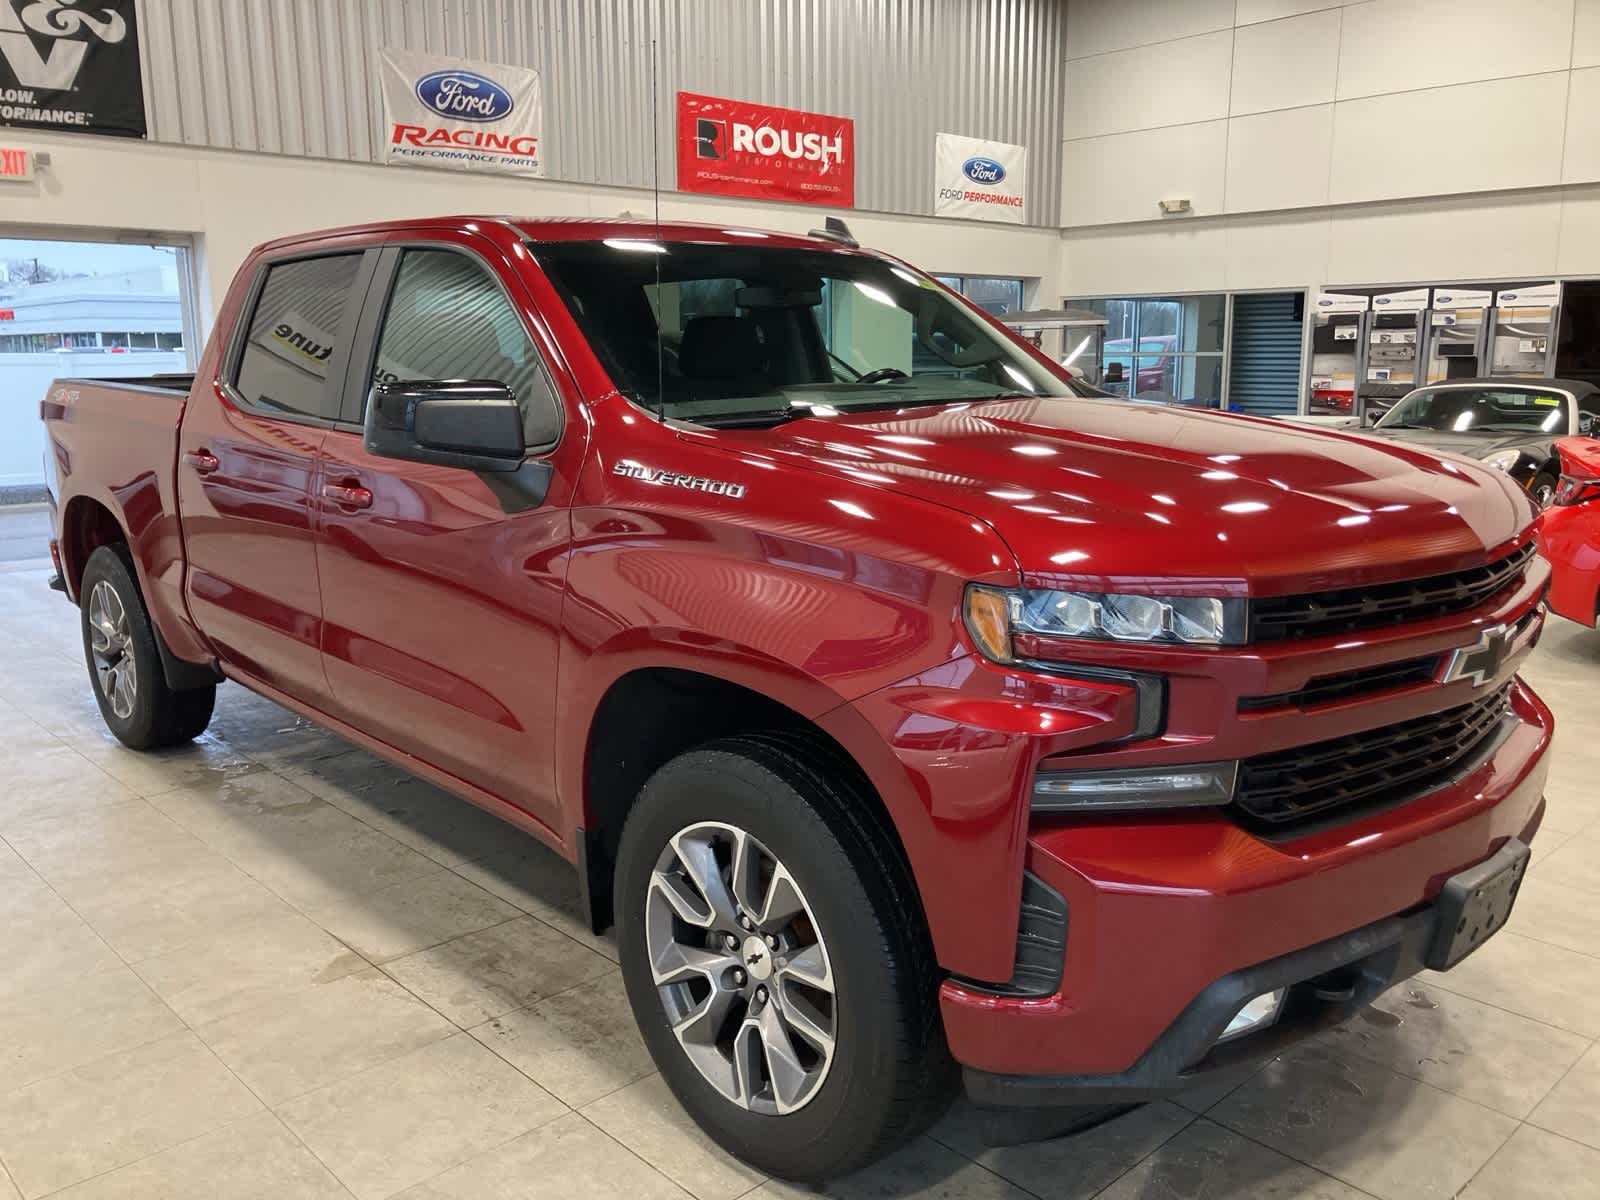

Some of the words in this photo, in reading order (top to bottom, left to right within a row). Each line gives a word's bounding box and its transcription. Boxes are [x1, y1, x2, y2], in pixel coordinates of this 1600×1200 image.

[435, 77, 496, 116] Ford
[0, 105, 91, 126] ORMANCE.
[392, 124, 538, 156] RACING
[733, 123, 843, 164] ROUSH
[392, 147, 497, 163] PERFORMANCE
[501, 157, 538, 167] PARTS
[970, 160, 997, 181] Ford
[940, 188, 963, 201] FORD
[963, 191, 1024, 207] PERFORMANCE
[612, 459, 746, 499] SILVERADO
